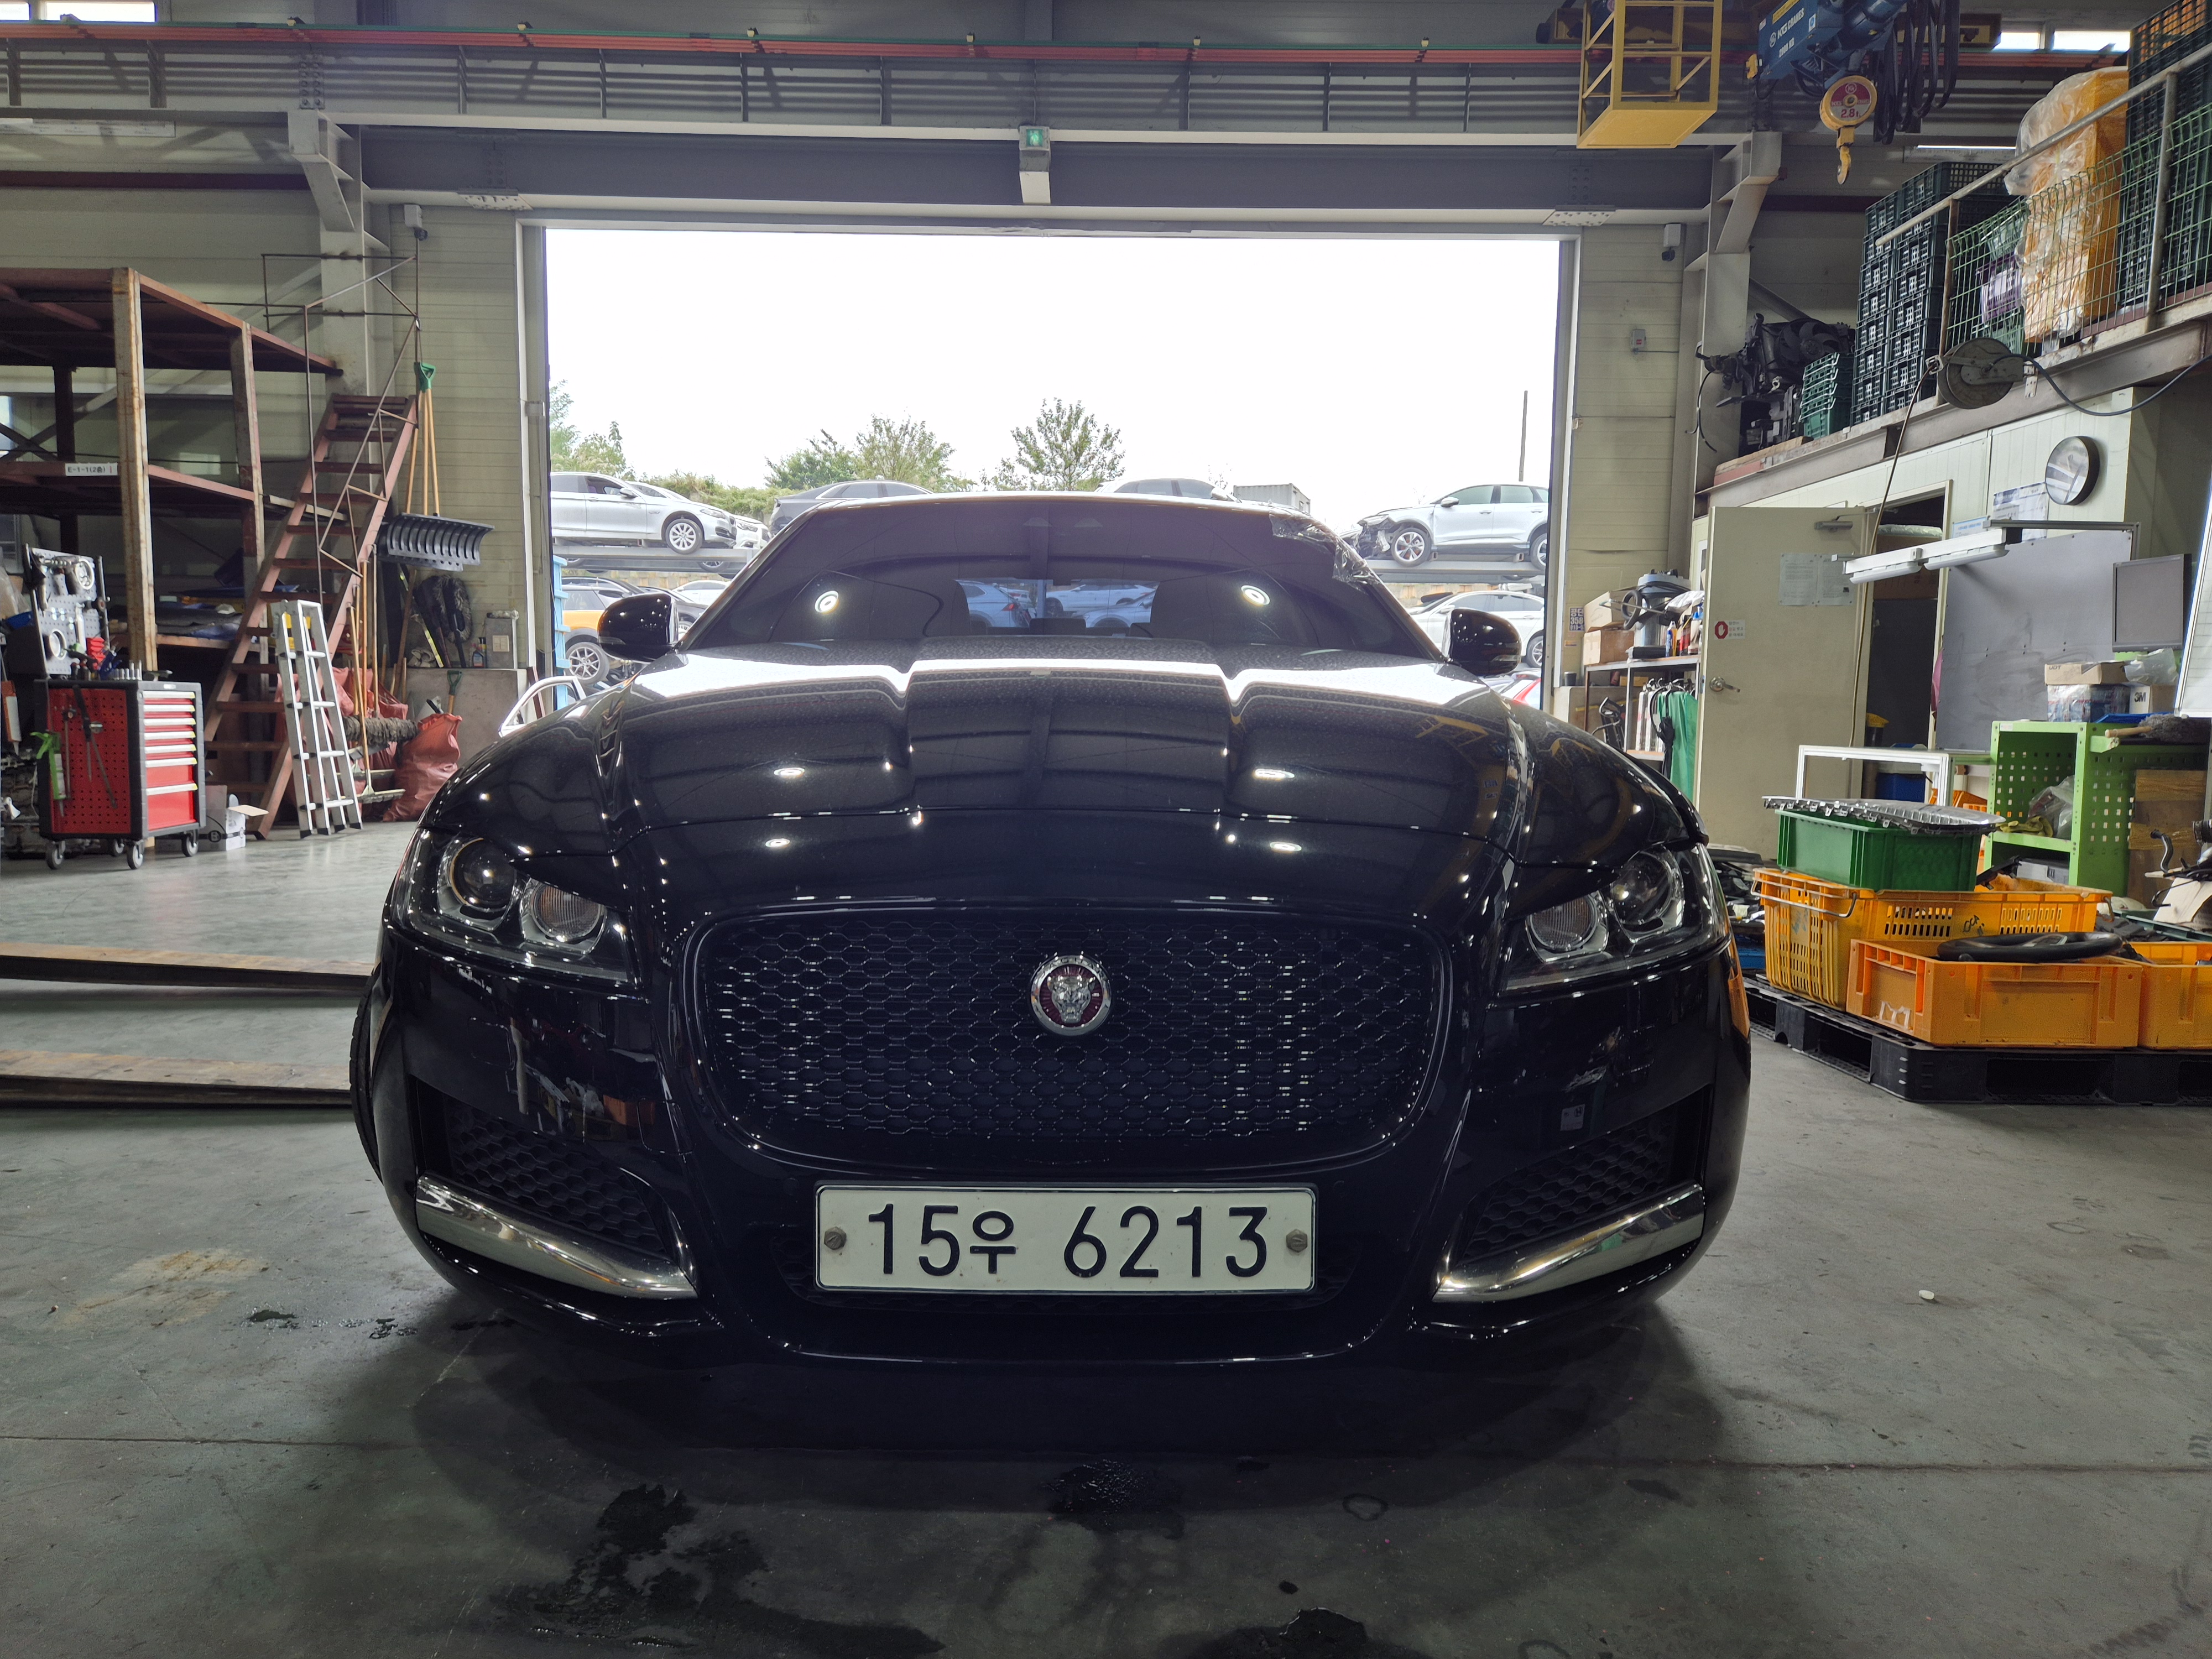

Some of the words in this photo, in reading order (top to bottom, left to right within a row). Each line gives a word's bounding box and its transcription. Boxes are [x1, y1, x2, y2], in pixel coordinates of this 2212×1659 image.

[2134, 692, 2146, 702] 3M
[869, 1203, 1016, 1276] 15우
[1064, 1206, 1268, 1278] 6213
